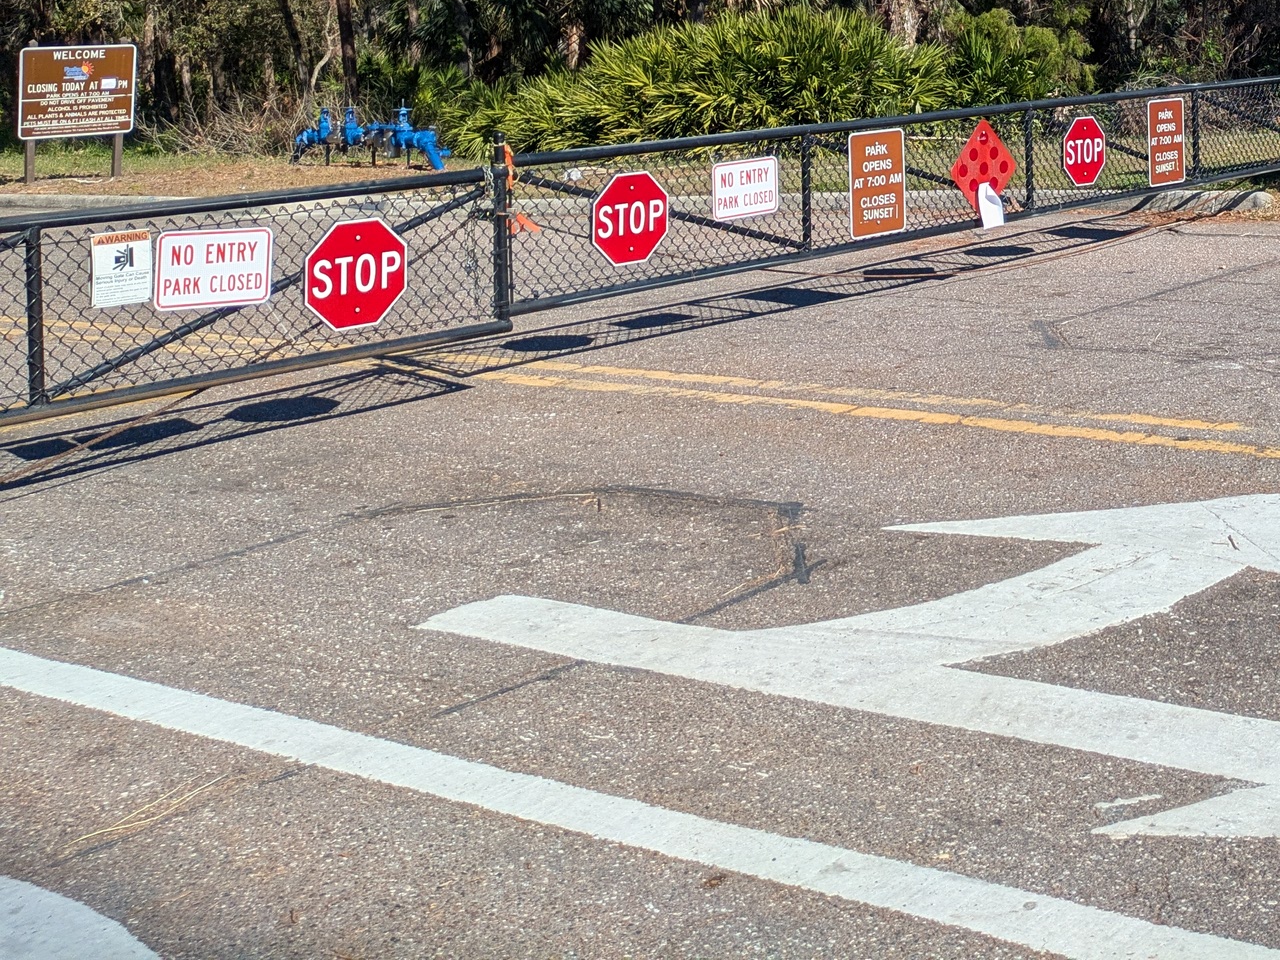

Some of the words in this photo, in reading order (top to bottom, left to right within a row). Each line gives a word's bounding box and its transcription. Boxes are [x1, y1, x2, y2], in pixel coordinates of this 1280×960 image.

[53, 49, 106, 60] WELCOME
[27, 83, 58, 94] CLOSING
[62, 81, 85, 92] TODAY
[89, 81, 98, 90] AT
[118, 79, 128, 89] PM
[1158, 110, 1173, 120] PARK
[1156, 122, 1176, 133] OPENS
[1151, 137, 1159, 146] AT
[1159, 135, 1172, 145] 7:00
[1173, 134, 1182, 143] AM
[865, 143, 888, 157] PARK
[1066, 137, 1103, 165] STOP
[1155, 150, 1178, 161] CLOSES
[862, 158, 893, 172] OPENS
[1155, 161, 1176, 174] SUNSET
[720, 171, 734, 189] NO
[739, 167, 770, 186] ENTRY
[853, 178, 864, 189] AT
[866, 175, 886, 187] 7:00
[888, 173, 902, 185] AM
[717, 195, 739, 211] PARK
[743, 191, 774, 207] CLOSED
[860, 193, 896, 208] CLOSES
[597, 198, 664, 239] STOP
[863, 207, 894, 220] SUNSET
[105, 232, 148, 244] WARNING
[171, 244, 194, 266] NO
[205, 241, 258, 264] ENTRY
[311, 249, 402, 299] STOP
[163, 276, 201, 296] PARK
[209, 272, 263, 293] CLOSED
